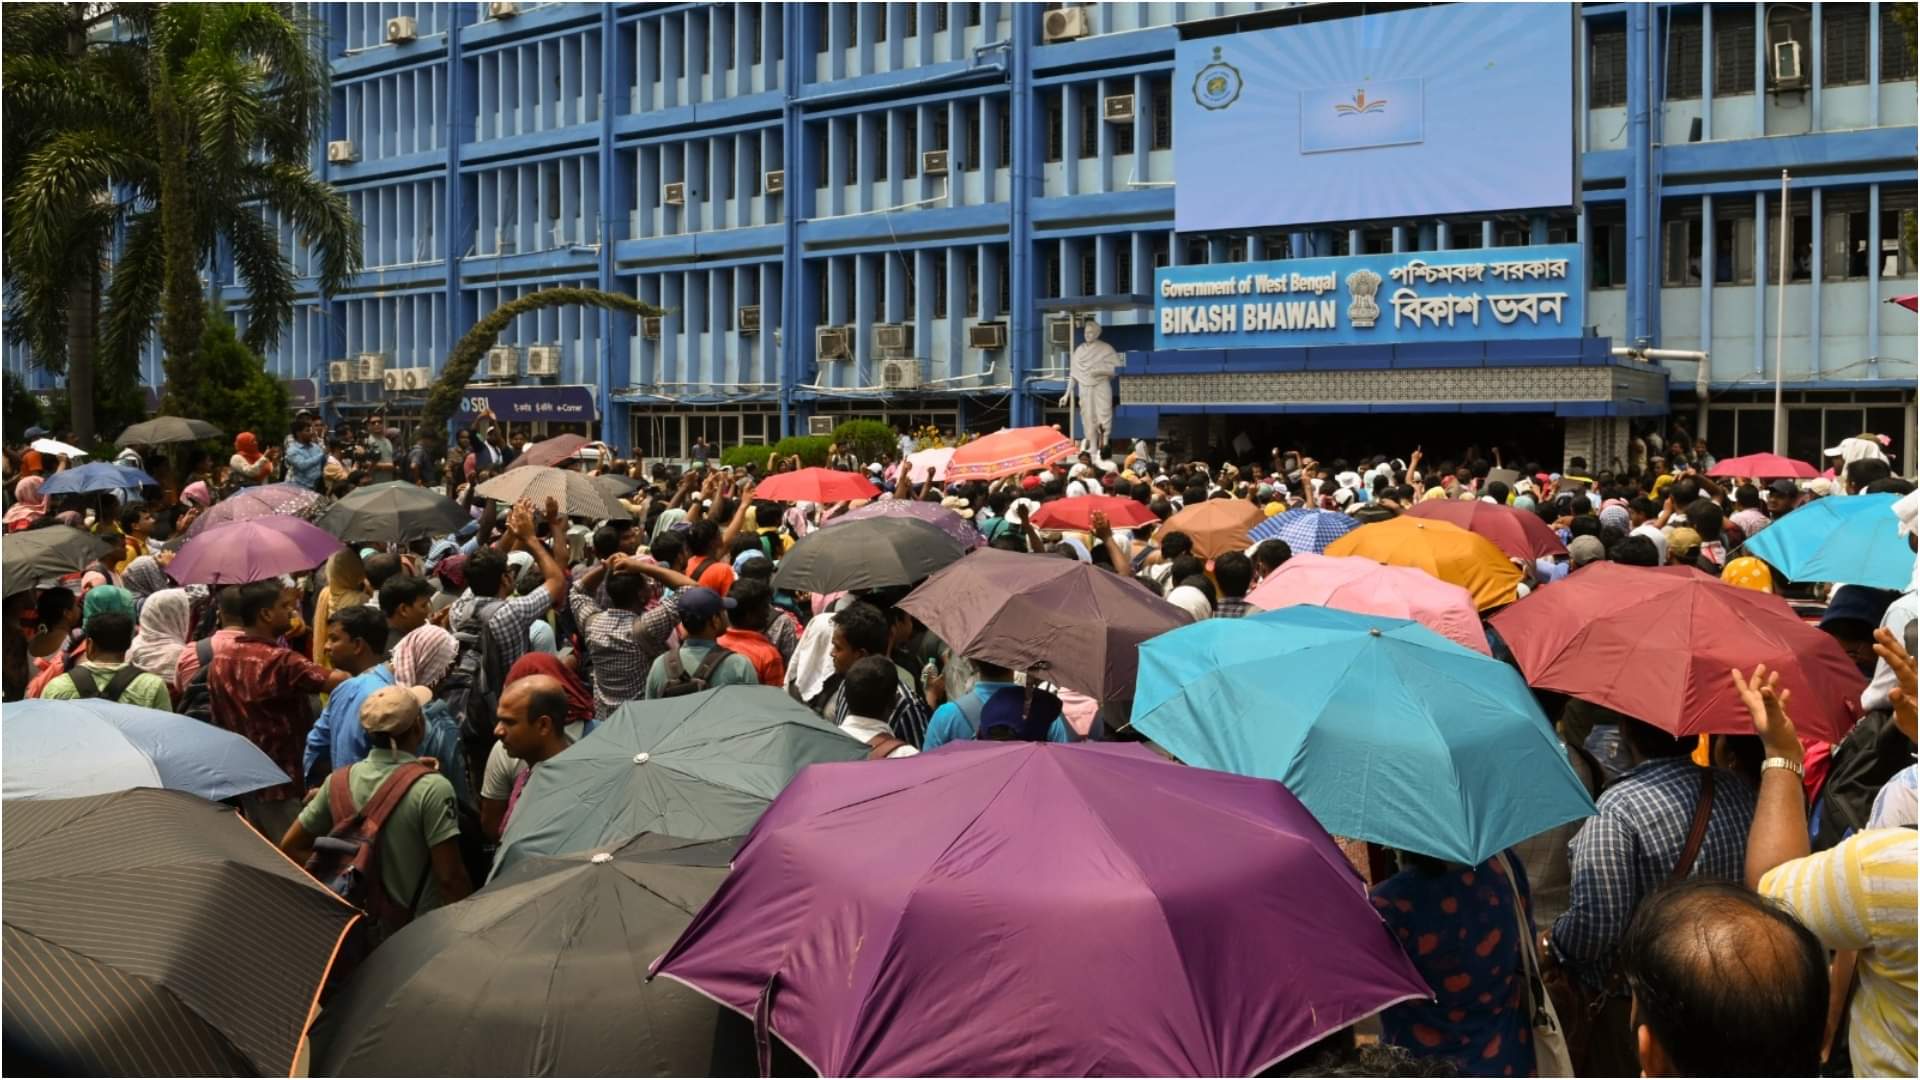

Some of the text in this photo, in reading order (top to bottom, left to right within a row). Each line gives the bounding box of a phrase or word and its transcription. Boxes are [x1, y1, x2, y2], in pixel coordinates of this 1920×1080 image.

[1161, 270, 1337, 298] Government of West Bengal
[1389, 257, 1569, 285] পশ্চিমবঙ্গ সরকার
[1161, 299, 1337, 335] BIKASH BHAWAN
[1389, 287, 1569, 329] বিকাশ ভবন
[471, 396, 489, 413] SBI
